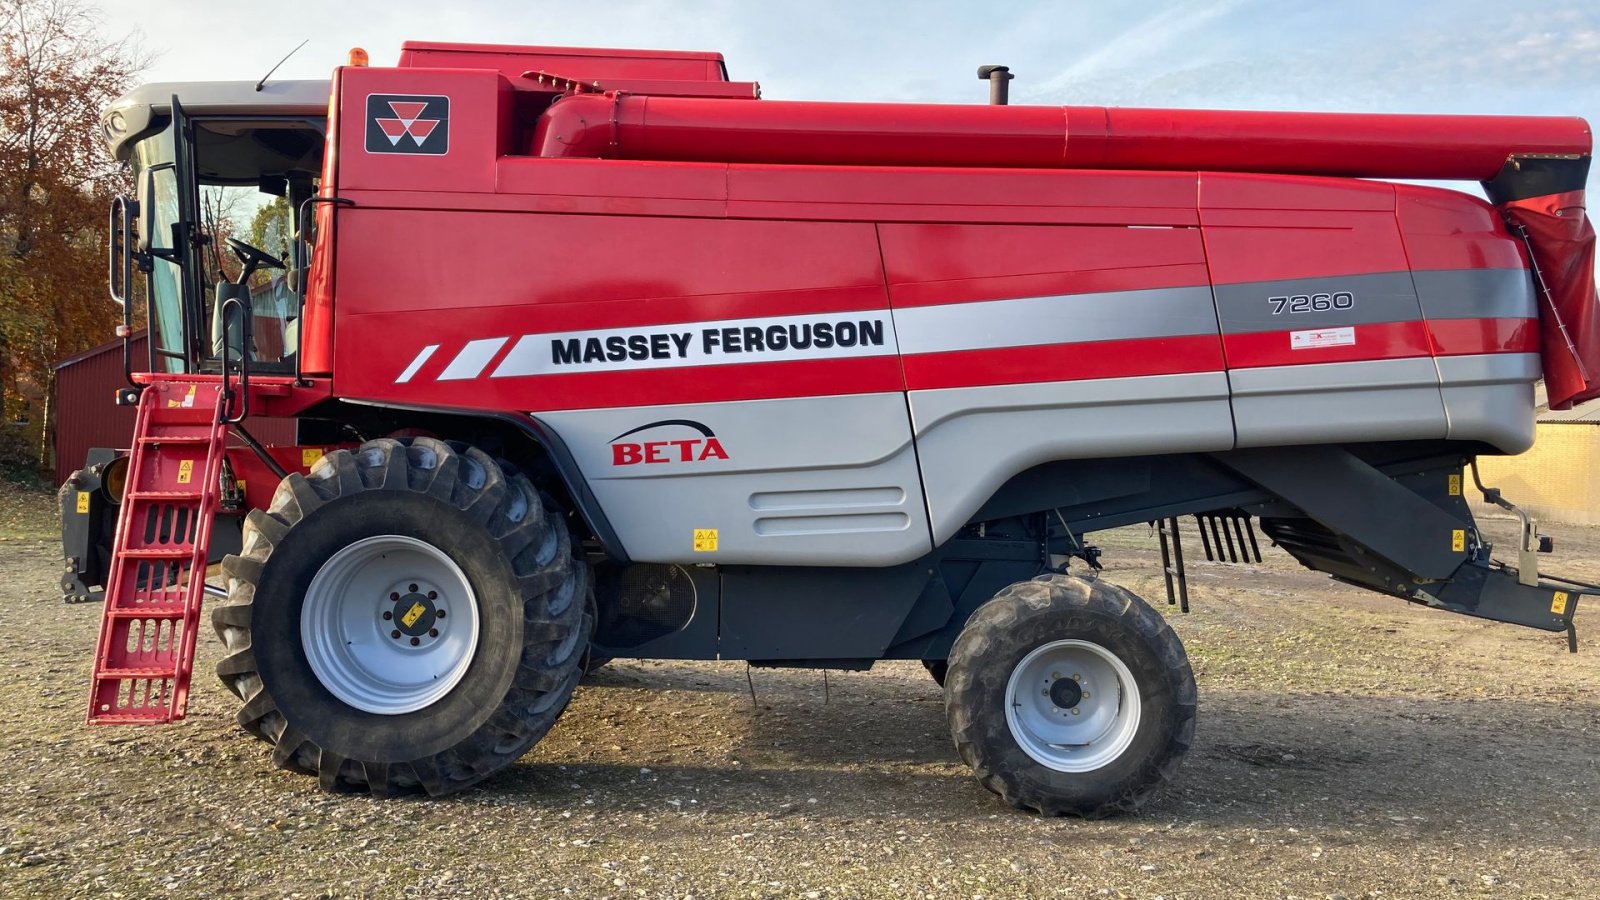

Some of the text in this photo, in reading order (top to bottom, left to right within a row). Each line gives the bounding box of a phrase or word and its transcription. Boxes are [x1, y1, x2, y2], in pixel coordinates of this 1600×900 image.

[1268, 291, 1354, 315] 7260
[551, 319, 884, 365] MASSEY FERGUSON
[611, 437, 730, 466] BETA
